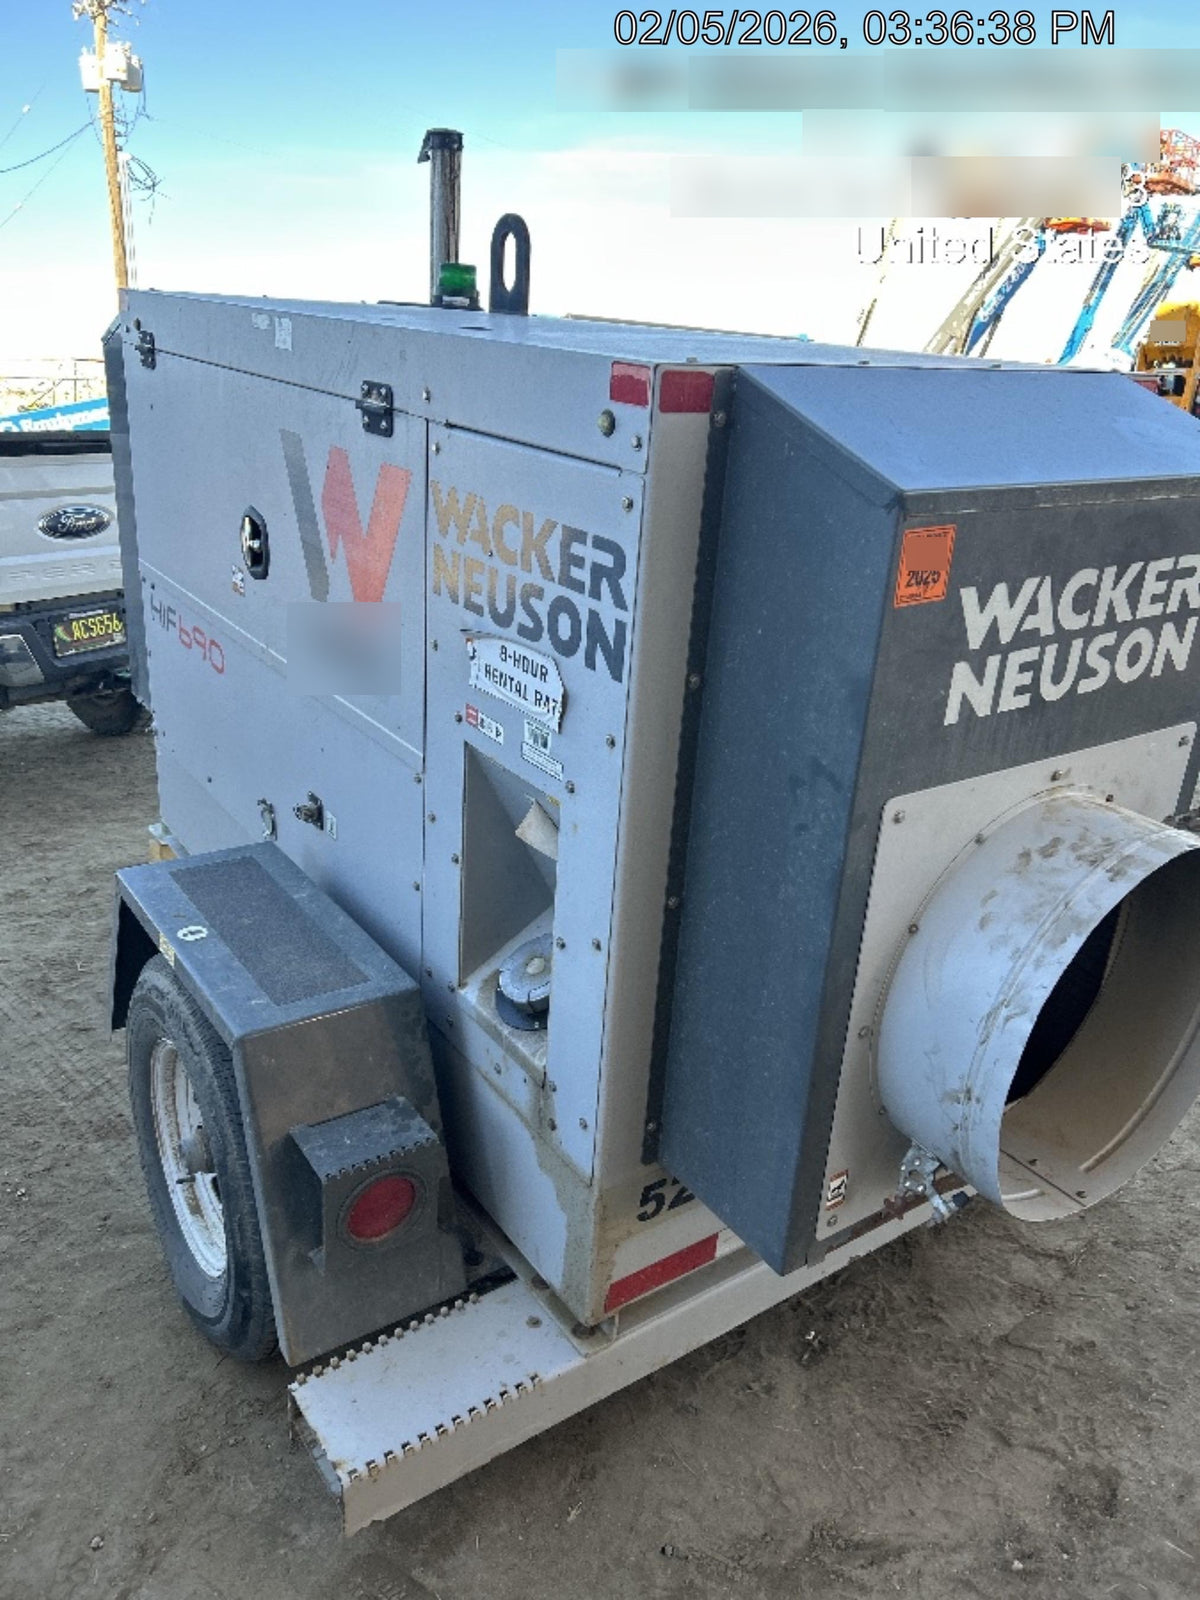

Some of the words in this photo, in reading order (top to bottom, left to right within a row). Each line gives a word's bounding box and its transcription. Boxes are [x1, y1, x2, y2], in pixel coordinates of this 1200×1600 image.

[430, 479, 628, 612] WACKER
[432, 542, 627, 684] NEUSON
[960, 553, 1200, 650] WACKER
[484, 662, 529, 702] RENTAL
[944, 616, 1200, 726] NEUSON
